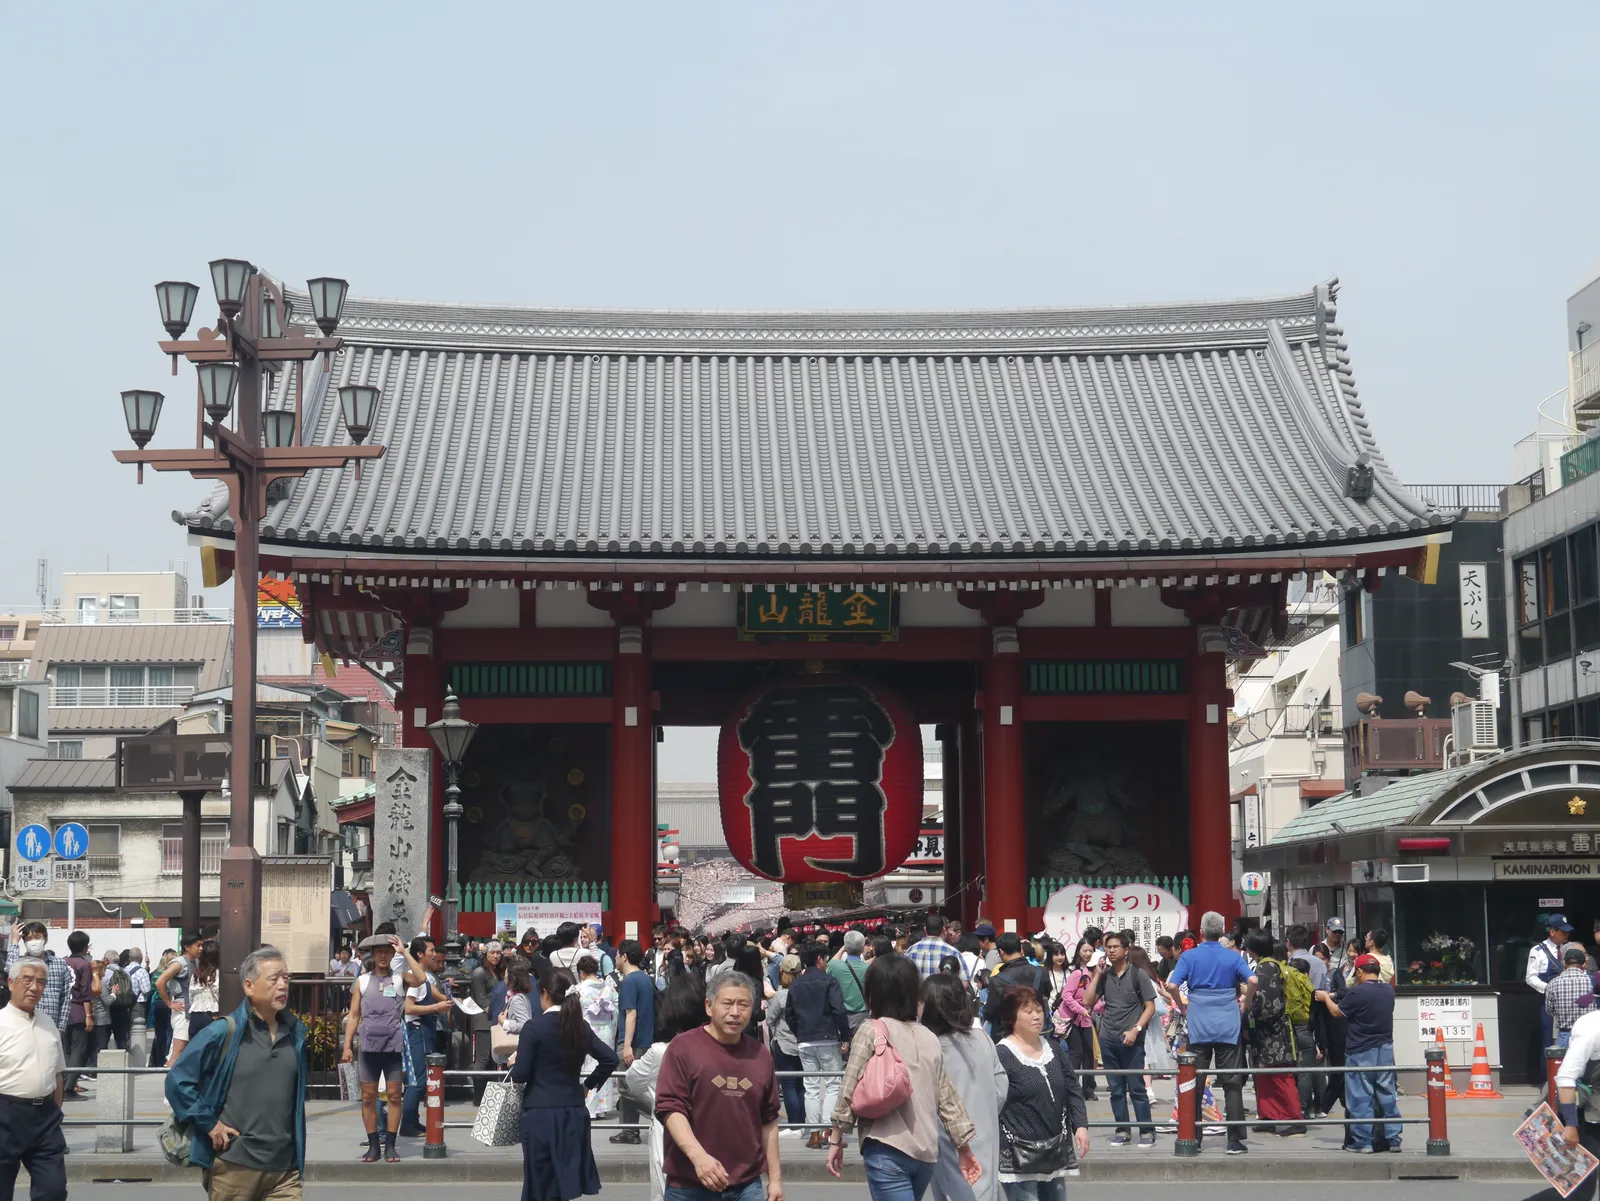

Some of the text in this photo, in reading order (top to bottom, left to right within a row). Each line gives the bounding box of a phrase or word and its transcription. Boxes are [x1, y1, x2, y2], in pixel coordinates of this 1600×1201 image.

[737, 684, 896, 879] 雷門
[1503, 864, 1591, 875] KAMINARIMON
[1075, 893, 1161, 912] 花まつり
[1420, 1012, 1436, 1020] 死亡
